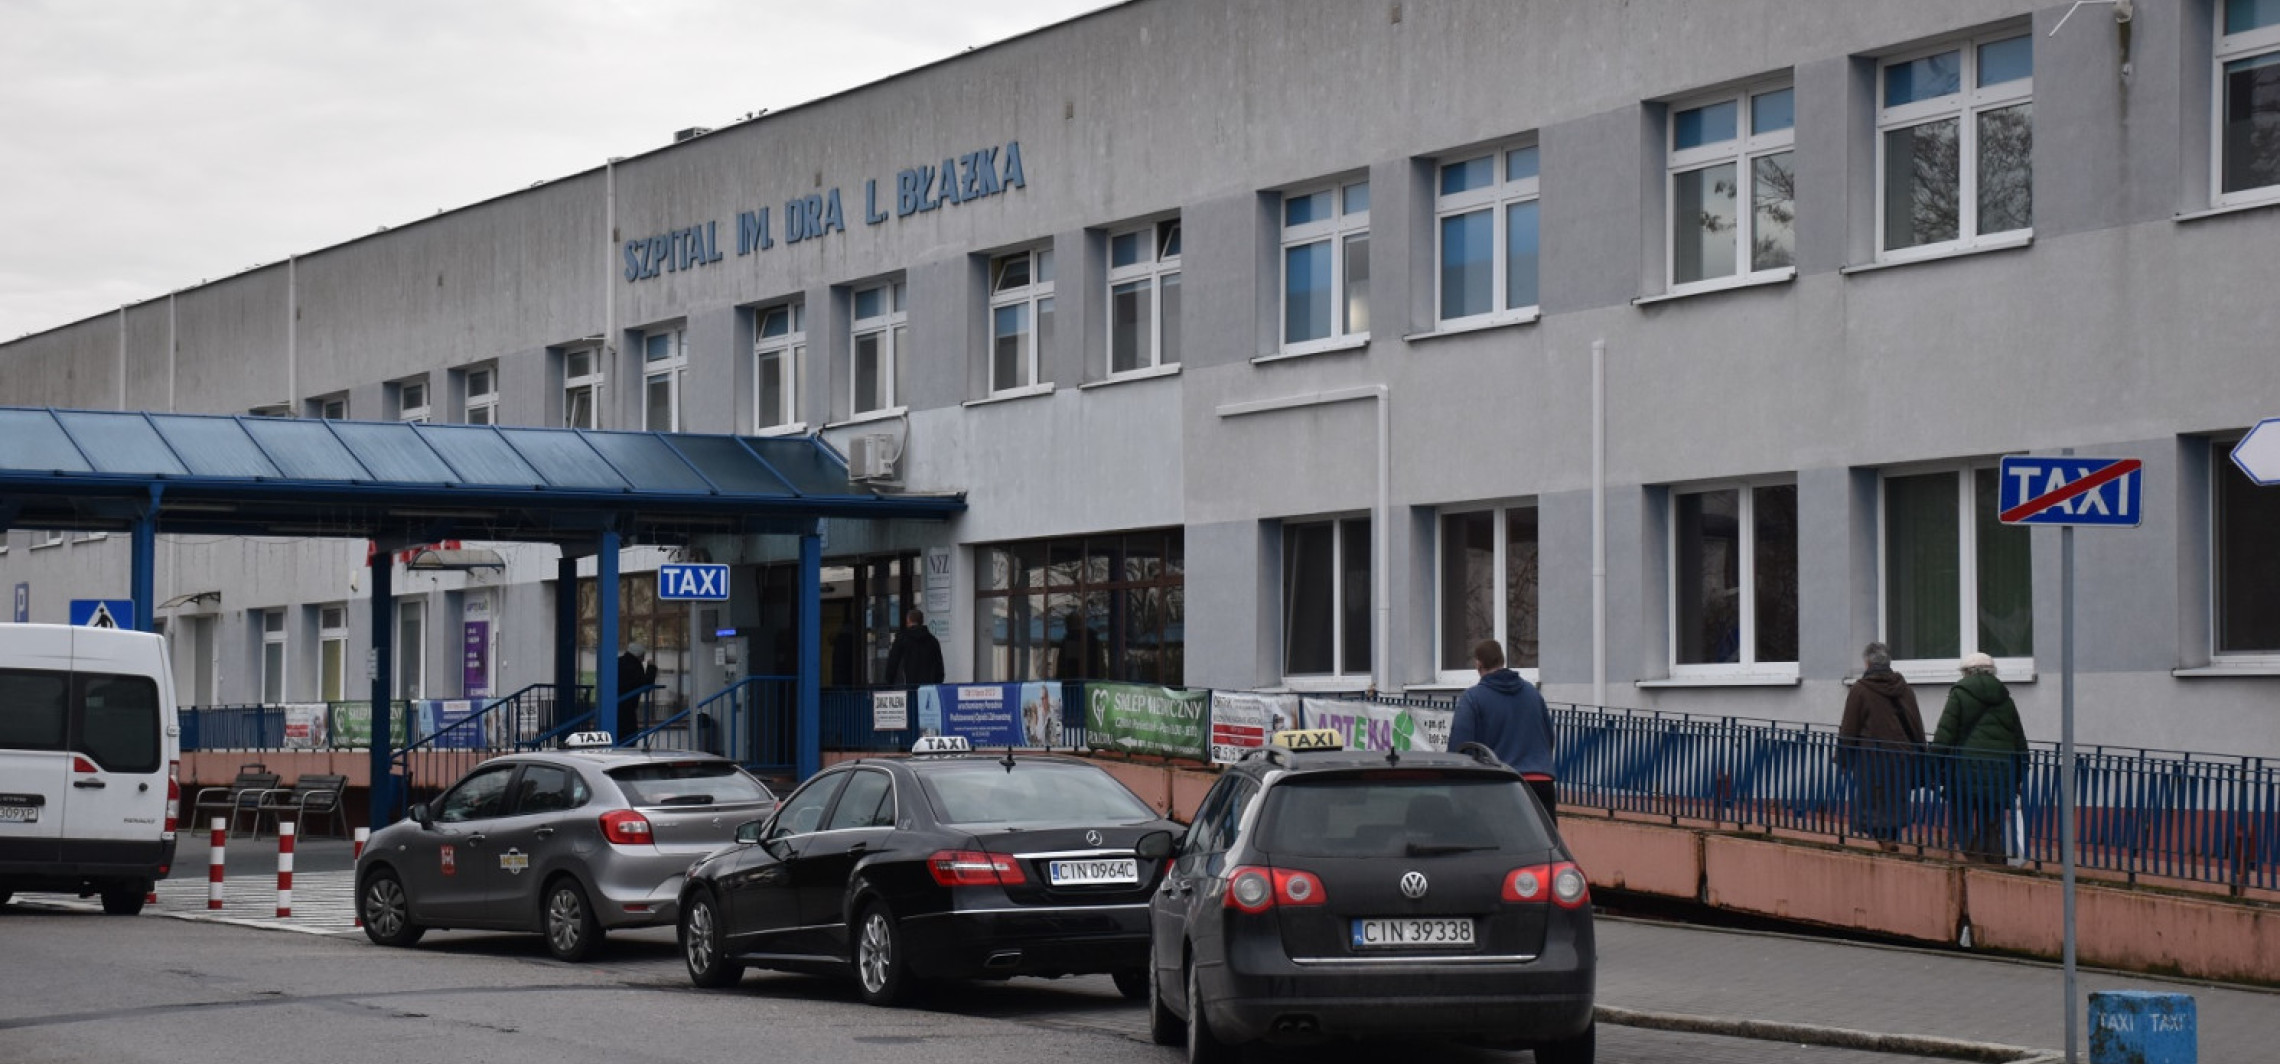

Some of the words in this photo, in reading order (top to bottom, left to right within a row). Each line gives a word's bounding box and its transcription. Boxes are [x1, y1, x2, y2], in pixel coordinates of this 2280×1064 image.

[623, 220, 723, 283] SZPITAL
[736, 205, 774, 257] IM.
[784, 187, 845, 245] DRA
[865, 178, 889, 225] L.
[2008, 465, 2130, 516] TAXI
[662, 567, 727, 596] TAXI
[1113, 692, 1146, 712] SKLEP
[577, 733, 609, 744] TAXI
[925, 738, 967, 750] TAXI
[1283, 732, 1335, 747] TAXI
[1060, 863, 1088, 880] CIN
[1090, 862, 1135, 879] 0964C
[1364, 921, 1404, 942] CIN
[1409, 921, 1471, 942] 39338
[2098, 1011, 2134, 1033] TAXI
[2150, 1013, 2184, 1033] TAXI
